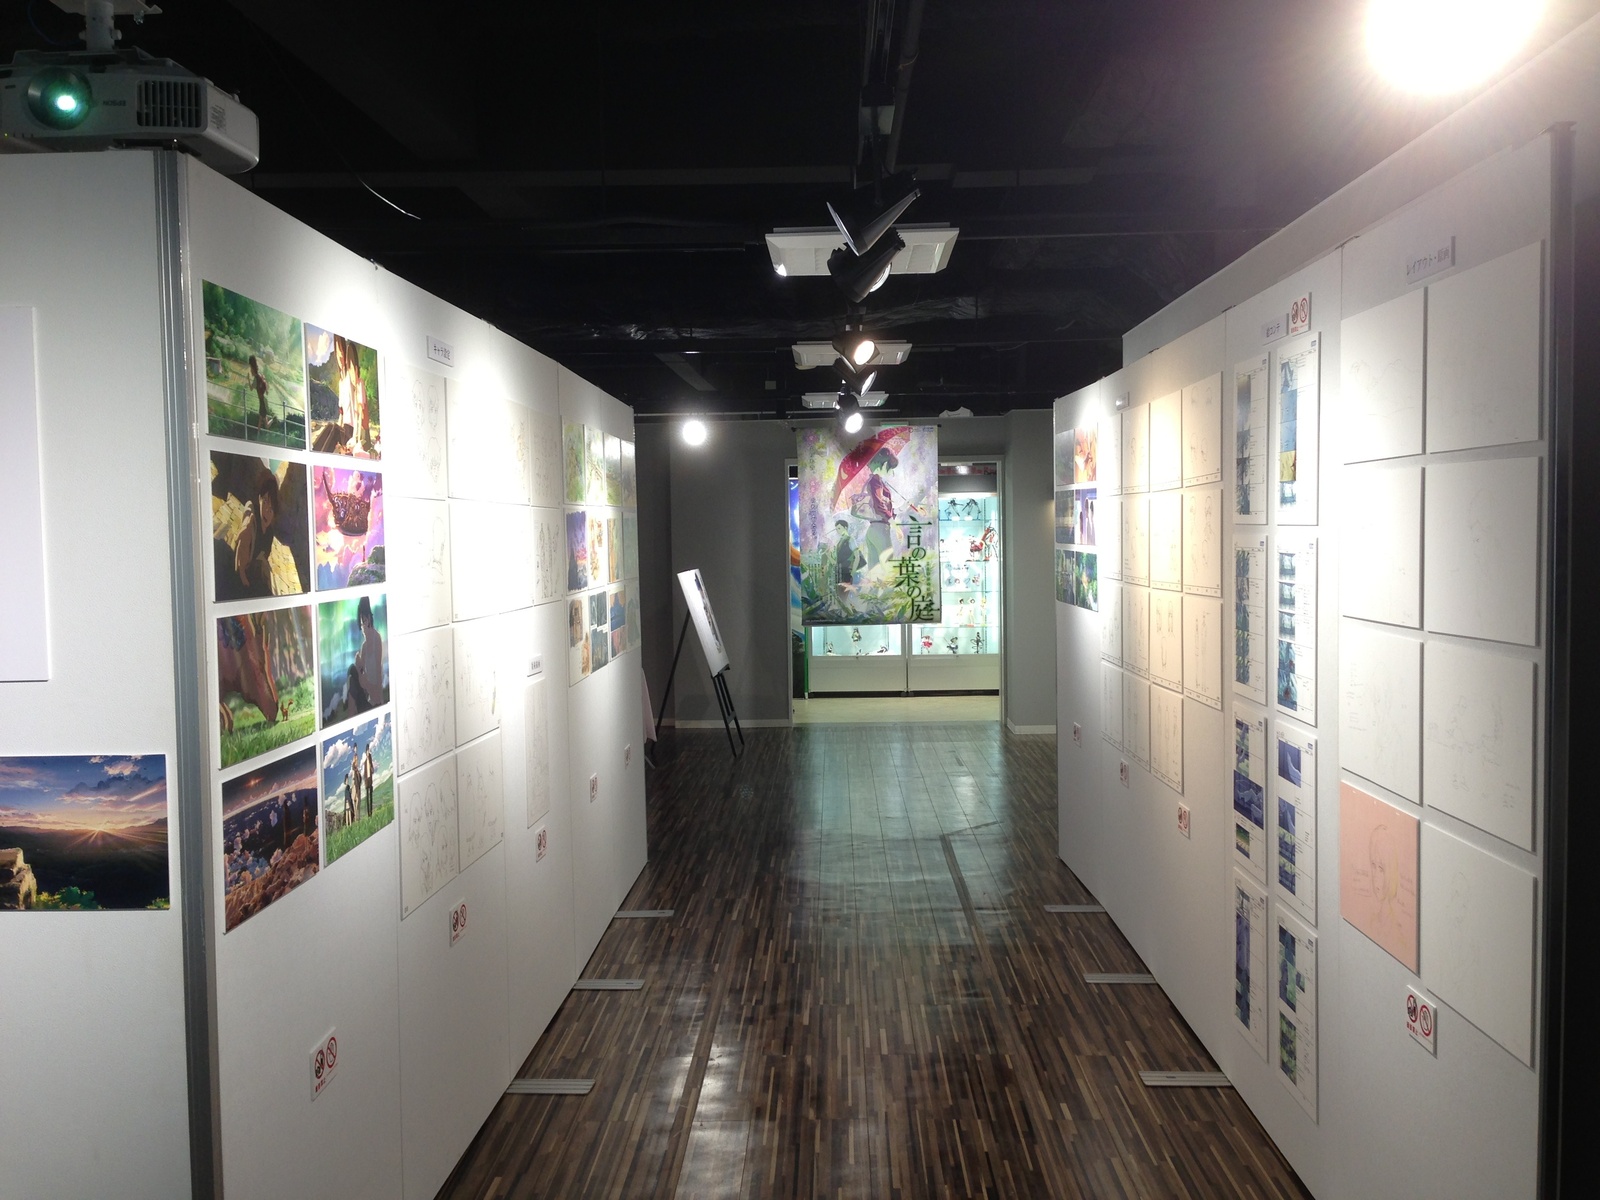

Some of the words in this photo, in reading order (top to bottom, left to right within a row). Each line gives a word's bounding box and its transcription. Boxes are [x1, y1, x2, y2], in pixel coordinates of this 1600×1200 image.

[888, 515, 940, 621] 言の葉の庭
